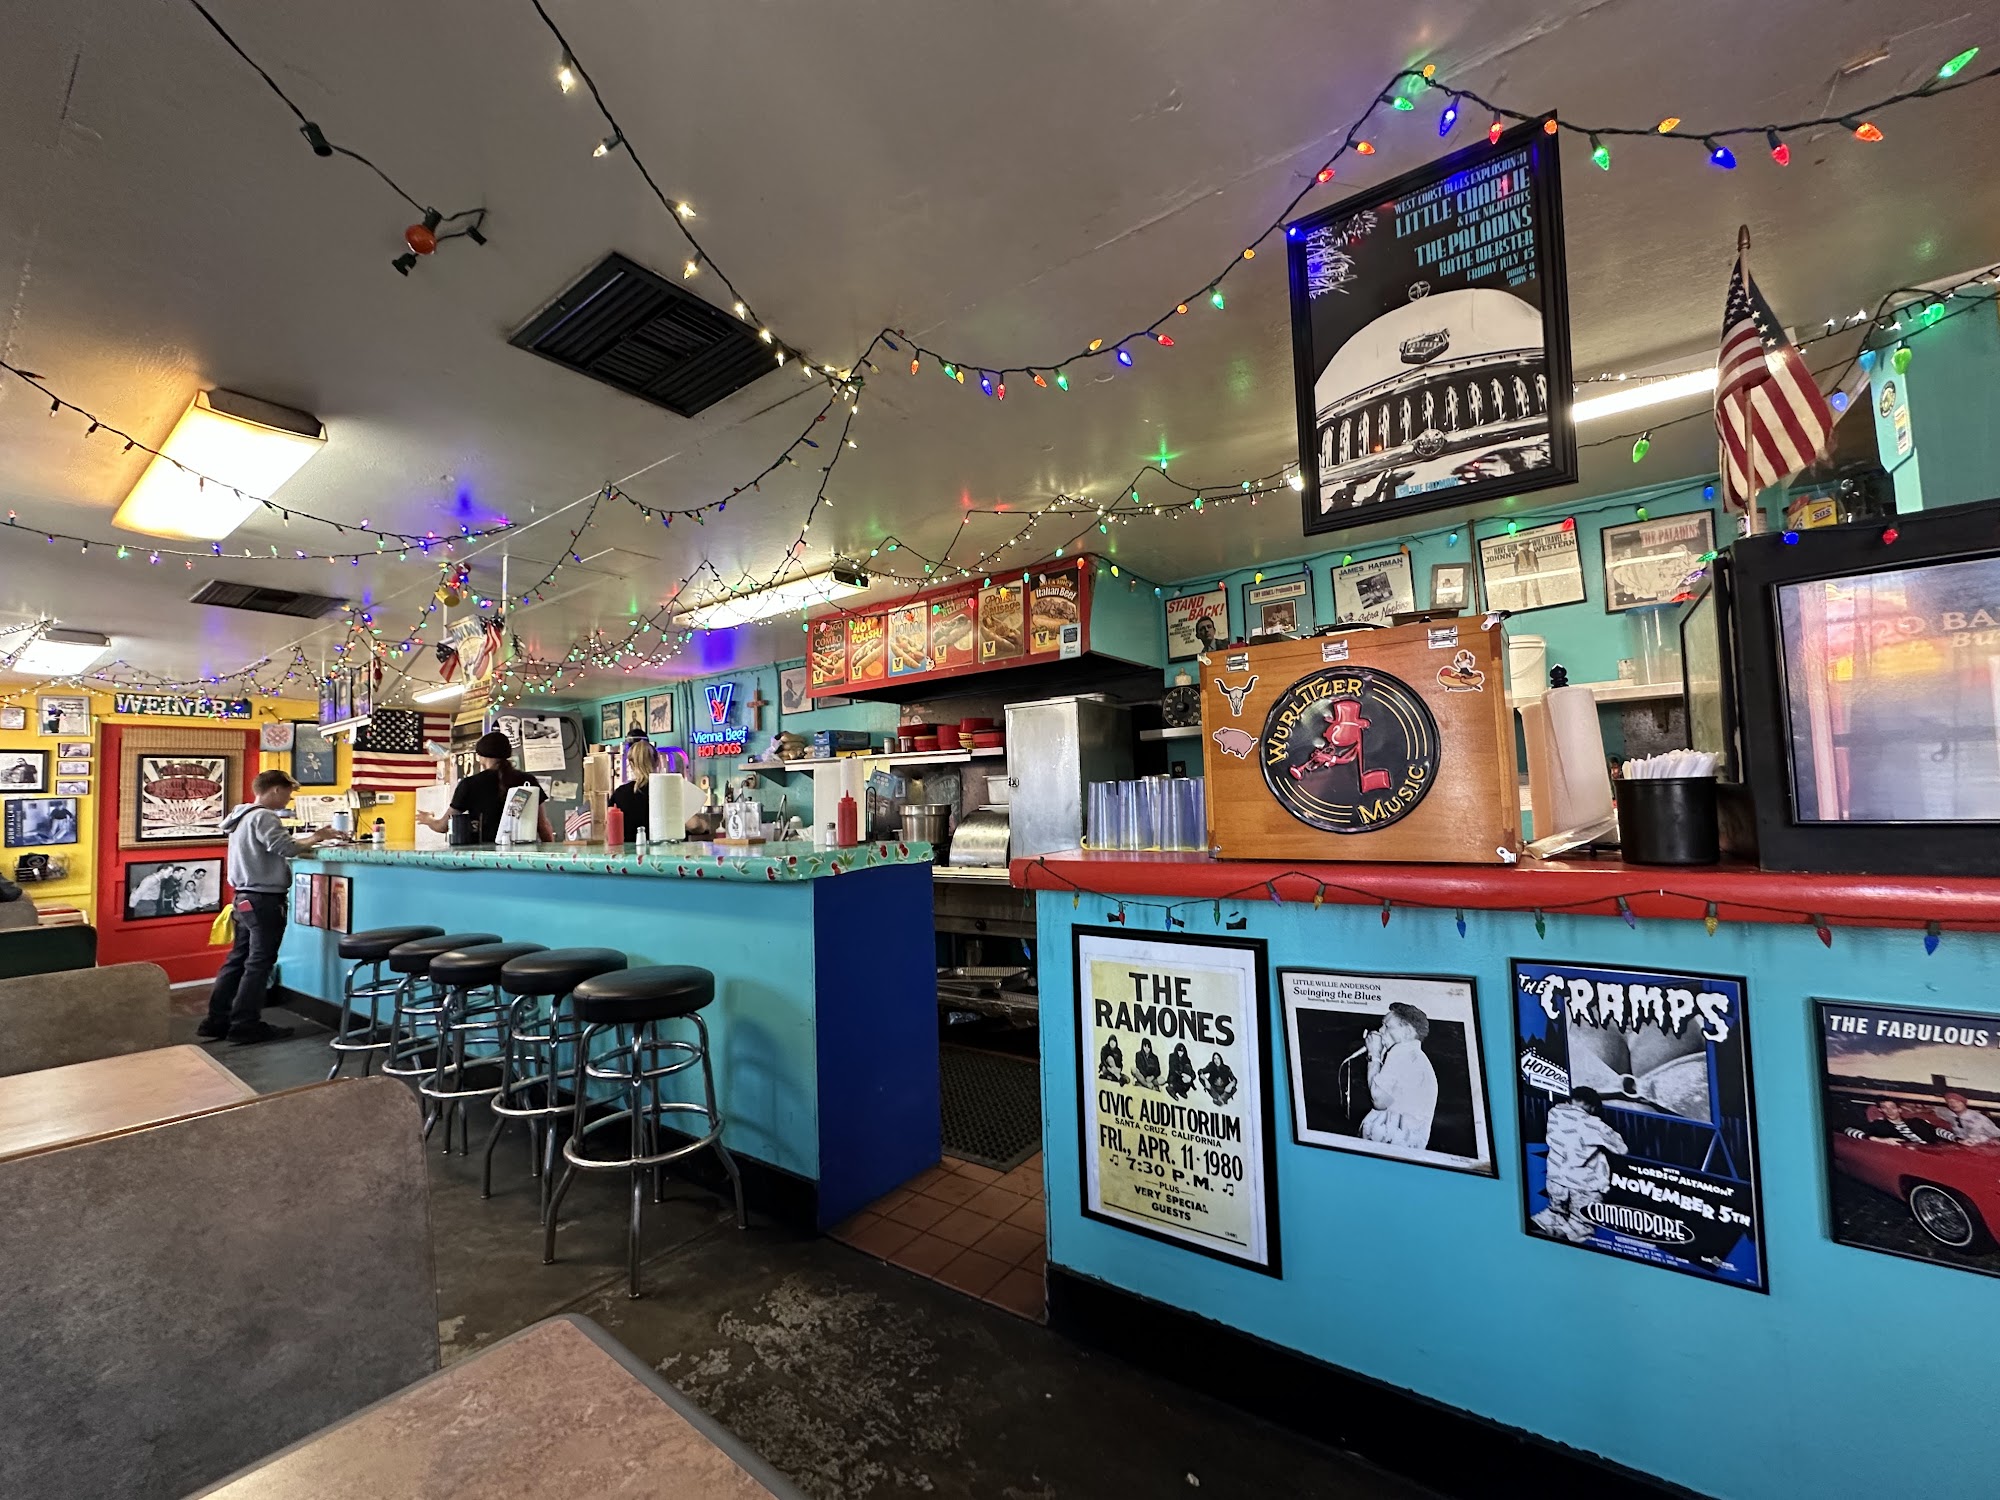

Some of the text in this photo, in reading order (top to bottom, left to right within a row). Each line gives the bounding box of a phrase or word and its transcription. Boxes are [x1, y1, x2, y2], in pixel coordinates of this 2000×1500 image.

[1394, 197, 1417, 215] WEST
[1395, 165, 1531, 239] LITTLE CHARLIE
[1414, 204, 1533, 267] THE PALADINS
[1439, 229, 1534, 277] KATIE WEBSTER
[1466, 246, 1535, 281] FRIDAY JULY 15
[1657, 524, 1699, 543] PALADINS
[1485, 539, 1575, 563] JOHNNY WESTERN
[1339, 557, 1403, 576] JAMES HARMAN
[982, 601, 1021, 616] Sausage
[1168, 596, 1225, 621] STAND BACK!
[851, 628, 883, 644] POLISH!
[853, 619, 872, 634] HOT
[693, 726, 748, 744] Vienna Beef
[1267, 677, 1363, 766] WURLITZER
[698, 742, 742, 757] HOT DOGS
[1128, 971, 1193, 1008] THE
[1293, 986, 1382, 1001] Swinging the Blues
[1339, 982, 1381, 991] ANDERSON
[1519, 973, 1548, 995] THE
[1095, 998, 1235, 1046] RAMONES
[1540, 974, 1730, 1043] CRAMPS
[1830, 1015, 1869, 1034] THE
[1877, 1020, 1990, 1047] FABULOUS
[1099, 1089, 1242, 1143] CIVIC AUDITORIUM
[1100, 1123, 1131, 1157] FRI.,
[1138, 1133, 1176, 1165] APR.
[1115, 1117, 1222, 1148] SANTA CRUZ, CALIFORNIA
[1126, 1157, 1215, 1192] 7:30 P.M.
[1159, 1181, 1180, 1194] PLUS
[1638, 1166, 1668, 1180] LORDS
[1678, 1176, 1735, 1197] ALTAMONT
[1134, 1184, 1209, 1214] VERY SPECIAL
[1151, 1202, 1192, 1221] GUESTS
[1611, 1172, 1751, 1227] NOVEMBER 5TH
[1587, 1201, 1686, 1242] COMMODORE
